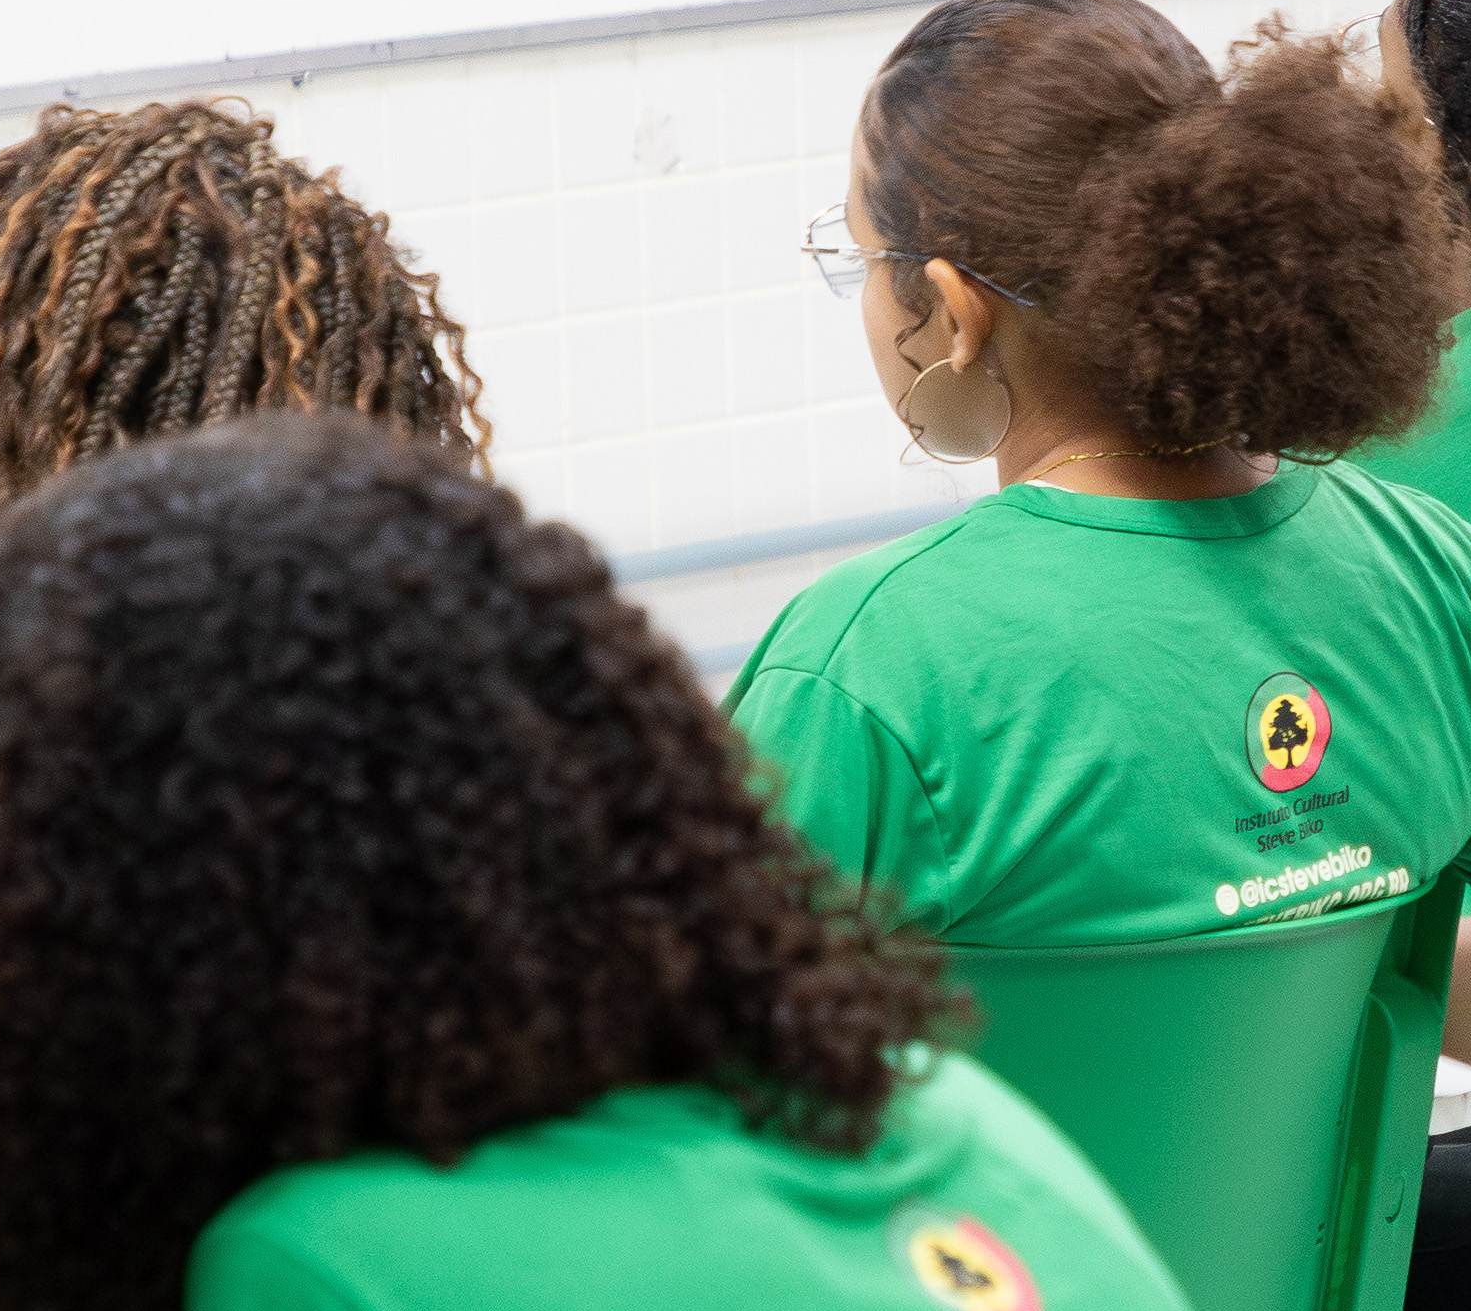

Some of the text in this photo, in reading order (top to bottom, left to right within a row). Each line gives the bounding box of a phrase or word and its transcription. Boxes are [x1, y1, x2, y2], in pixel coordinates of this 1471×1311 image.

[1234, 785, 1349, 834] Instituto Cultural
[1257, 818, 1324, 854] Steve Biko
[1240, 845, 1372, 908] @icstevebiko
